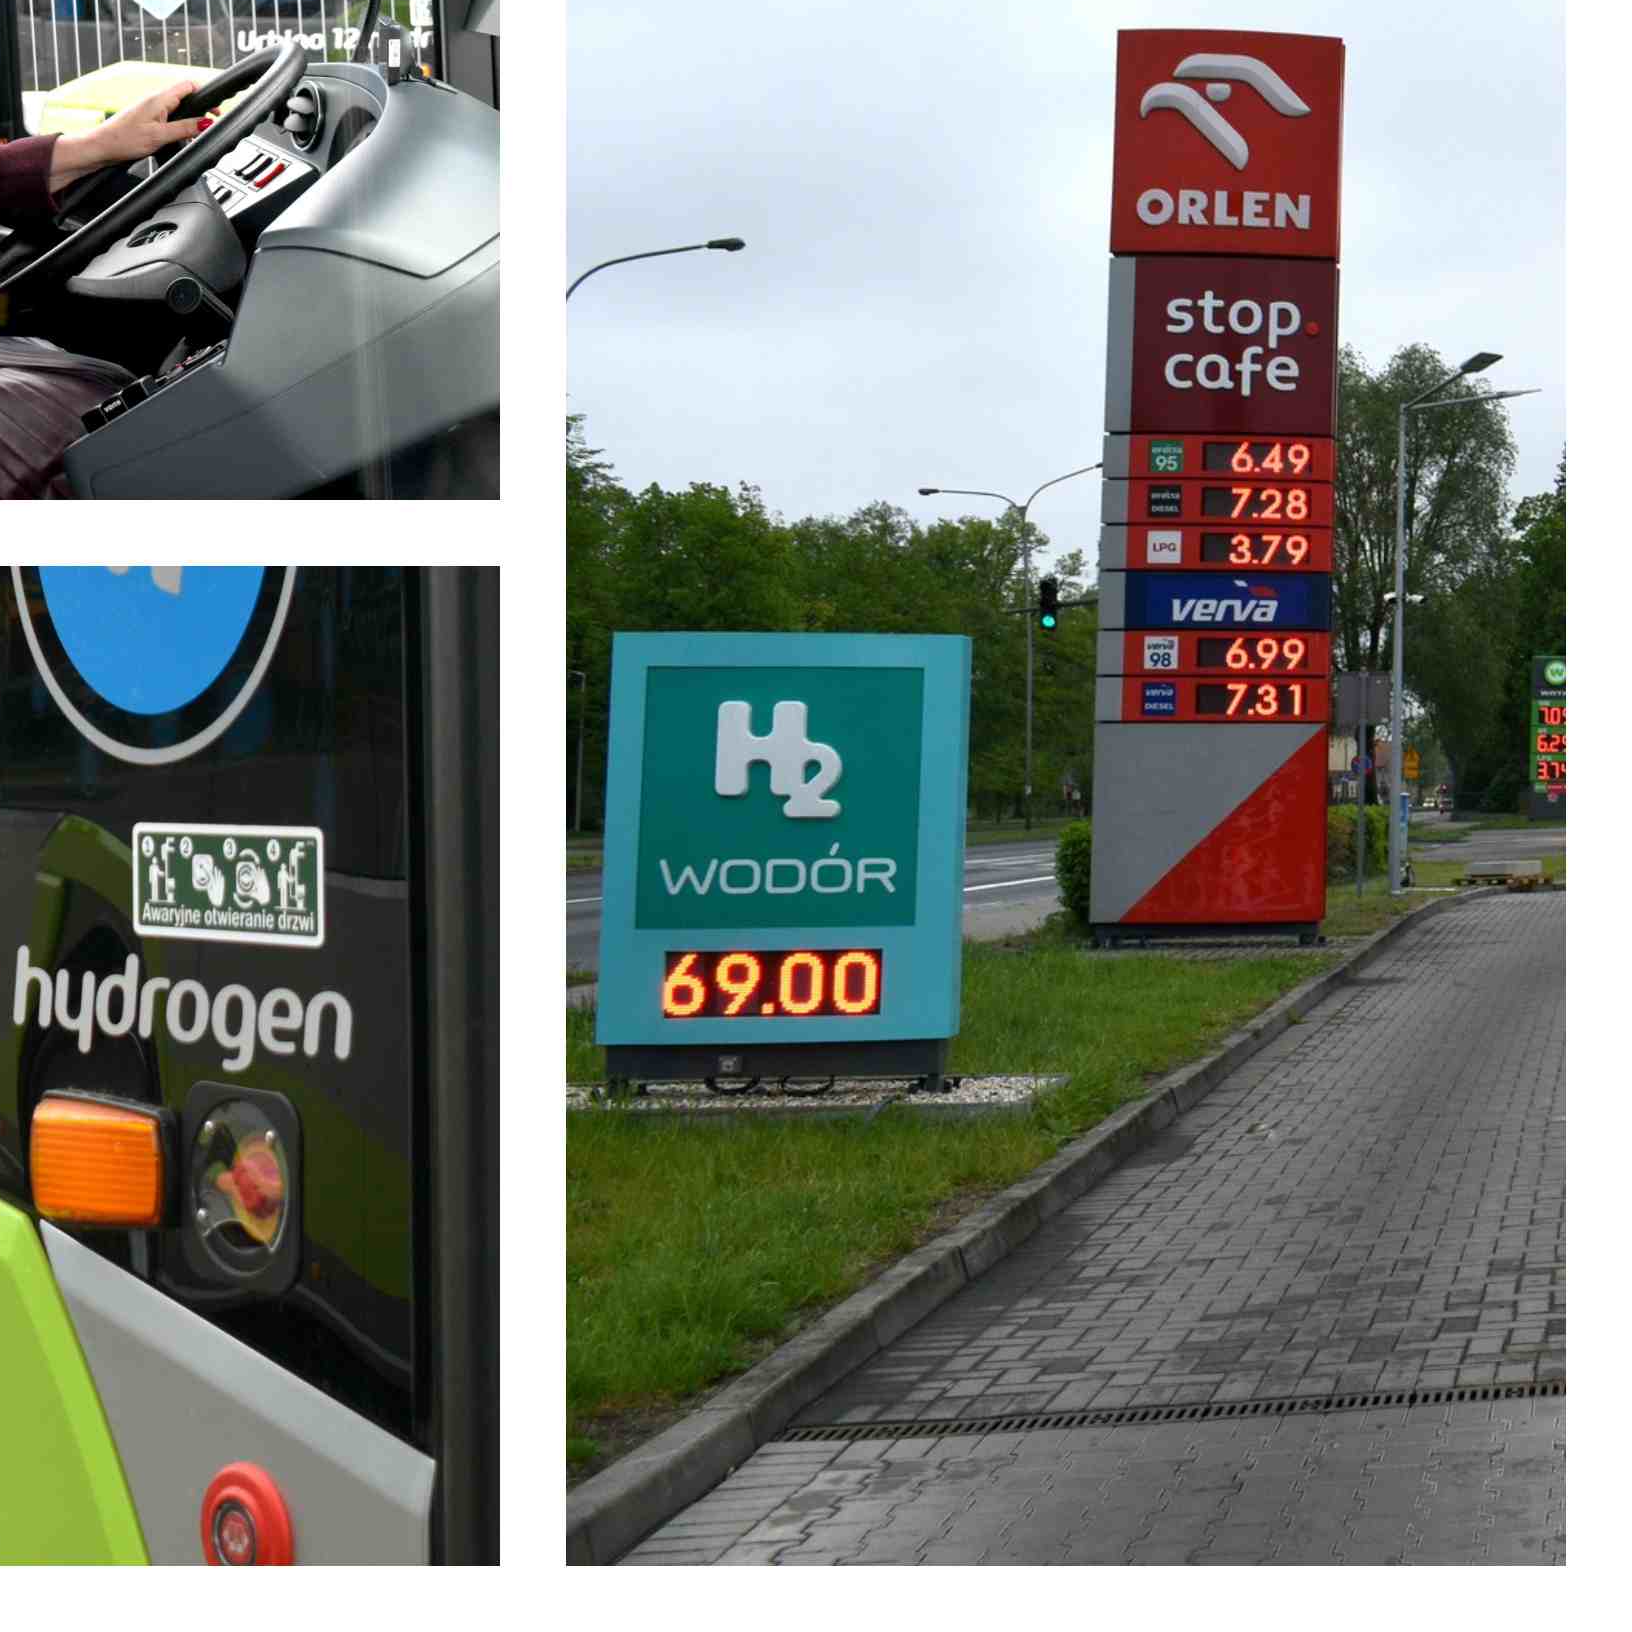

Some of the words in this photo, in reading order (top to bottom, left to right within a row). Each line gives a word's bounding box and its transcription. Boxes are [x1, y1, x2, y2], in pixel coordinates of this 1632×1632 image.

[1136, 188, 1311, 230] ORLEN
[1164, 346, 1299, 397] cafe
[1155, 455, 1179, 471] 95
[1231, 441, 1310, 474] 6.49
[1231, 487, 1308, 520] 7.28
[1152, 541, 1177, 553] LPG
[1229, 534, 1309, 565] 3.79
[1172, 598, 1279, 622] verva
[1149, 652, 1172, 668] 98
[1225, 637, 1305, 670] 6.99
[1144, 701, 1174, 711] DIESEL
[1225, 683, 1303, 716] 7.31
[714, 700, 843, 819] H2
[659, 842, 897, 896] WODÓR
[142, 903, 201, 927] Awaryjne
[204, 908, 274, 930] otwieranie
[278, 911, 315, 932] drzwi
[662, 951, 878, 1016] 69.00
[13, 944, 353, 1071] hydrogen
